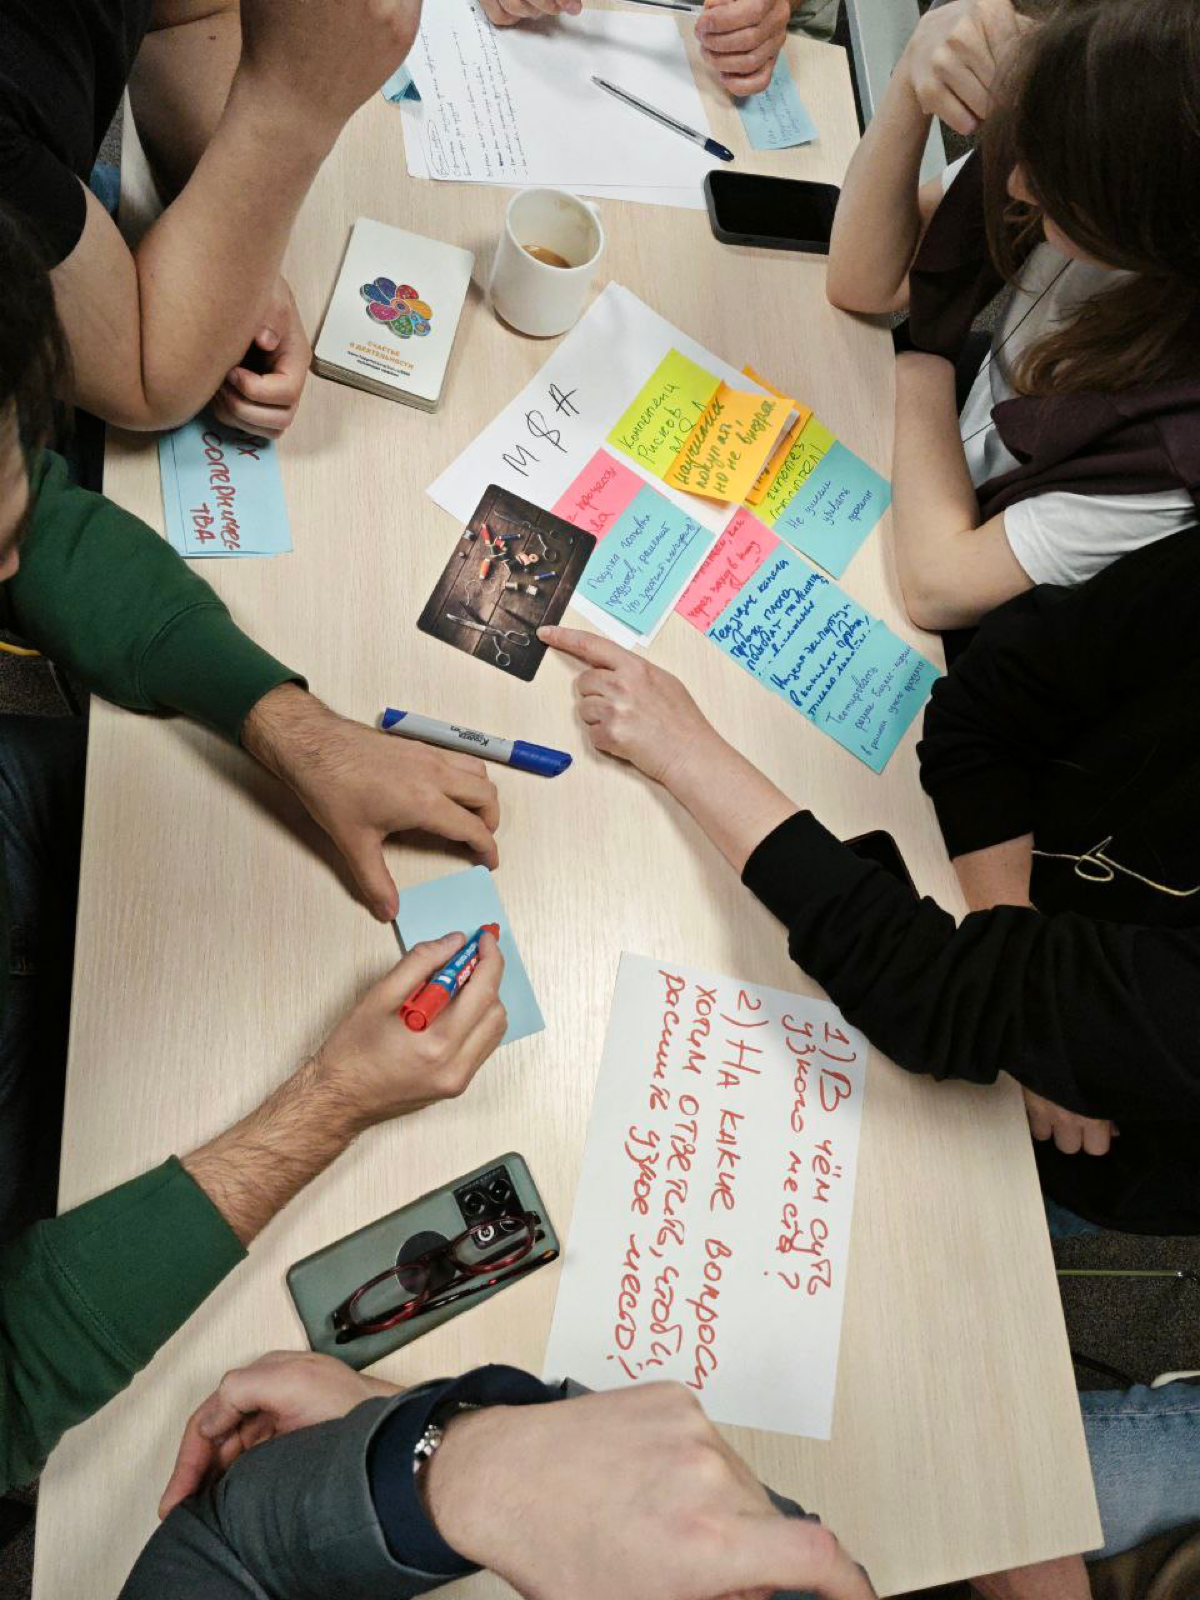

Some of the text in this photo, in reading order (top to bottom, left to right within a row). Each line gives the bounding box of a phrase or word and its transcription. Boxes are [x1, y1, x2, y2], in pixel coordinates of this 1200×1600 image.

[682, 986, 717, 1072] хотим
[781, 1016, 815, 1133] узкого
[624, 1127, 660, 1217] узкое
[812, 1140, 842, 1203] чём
